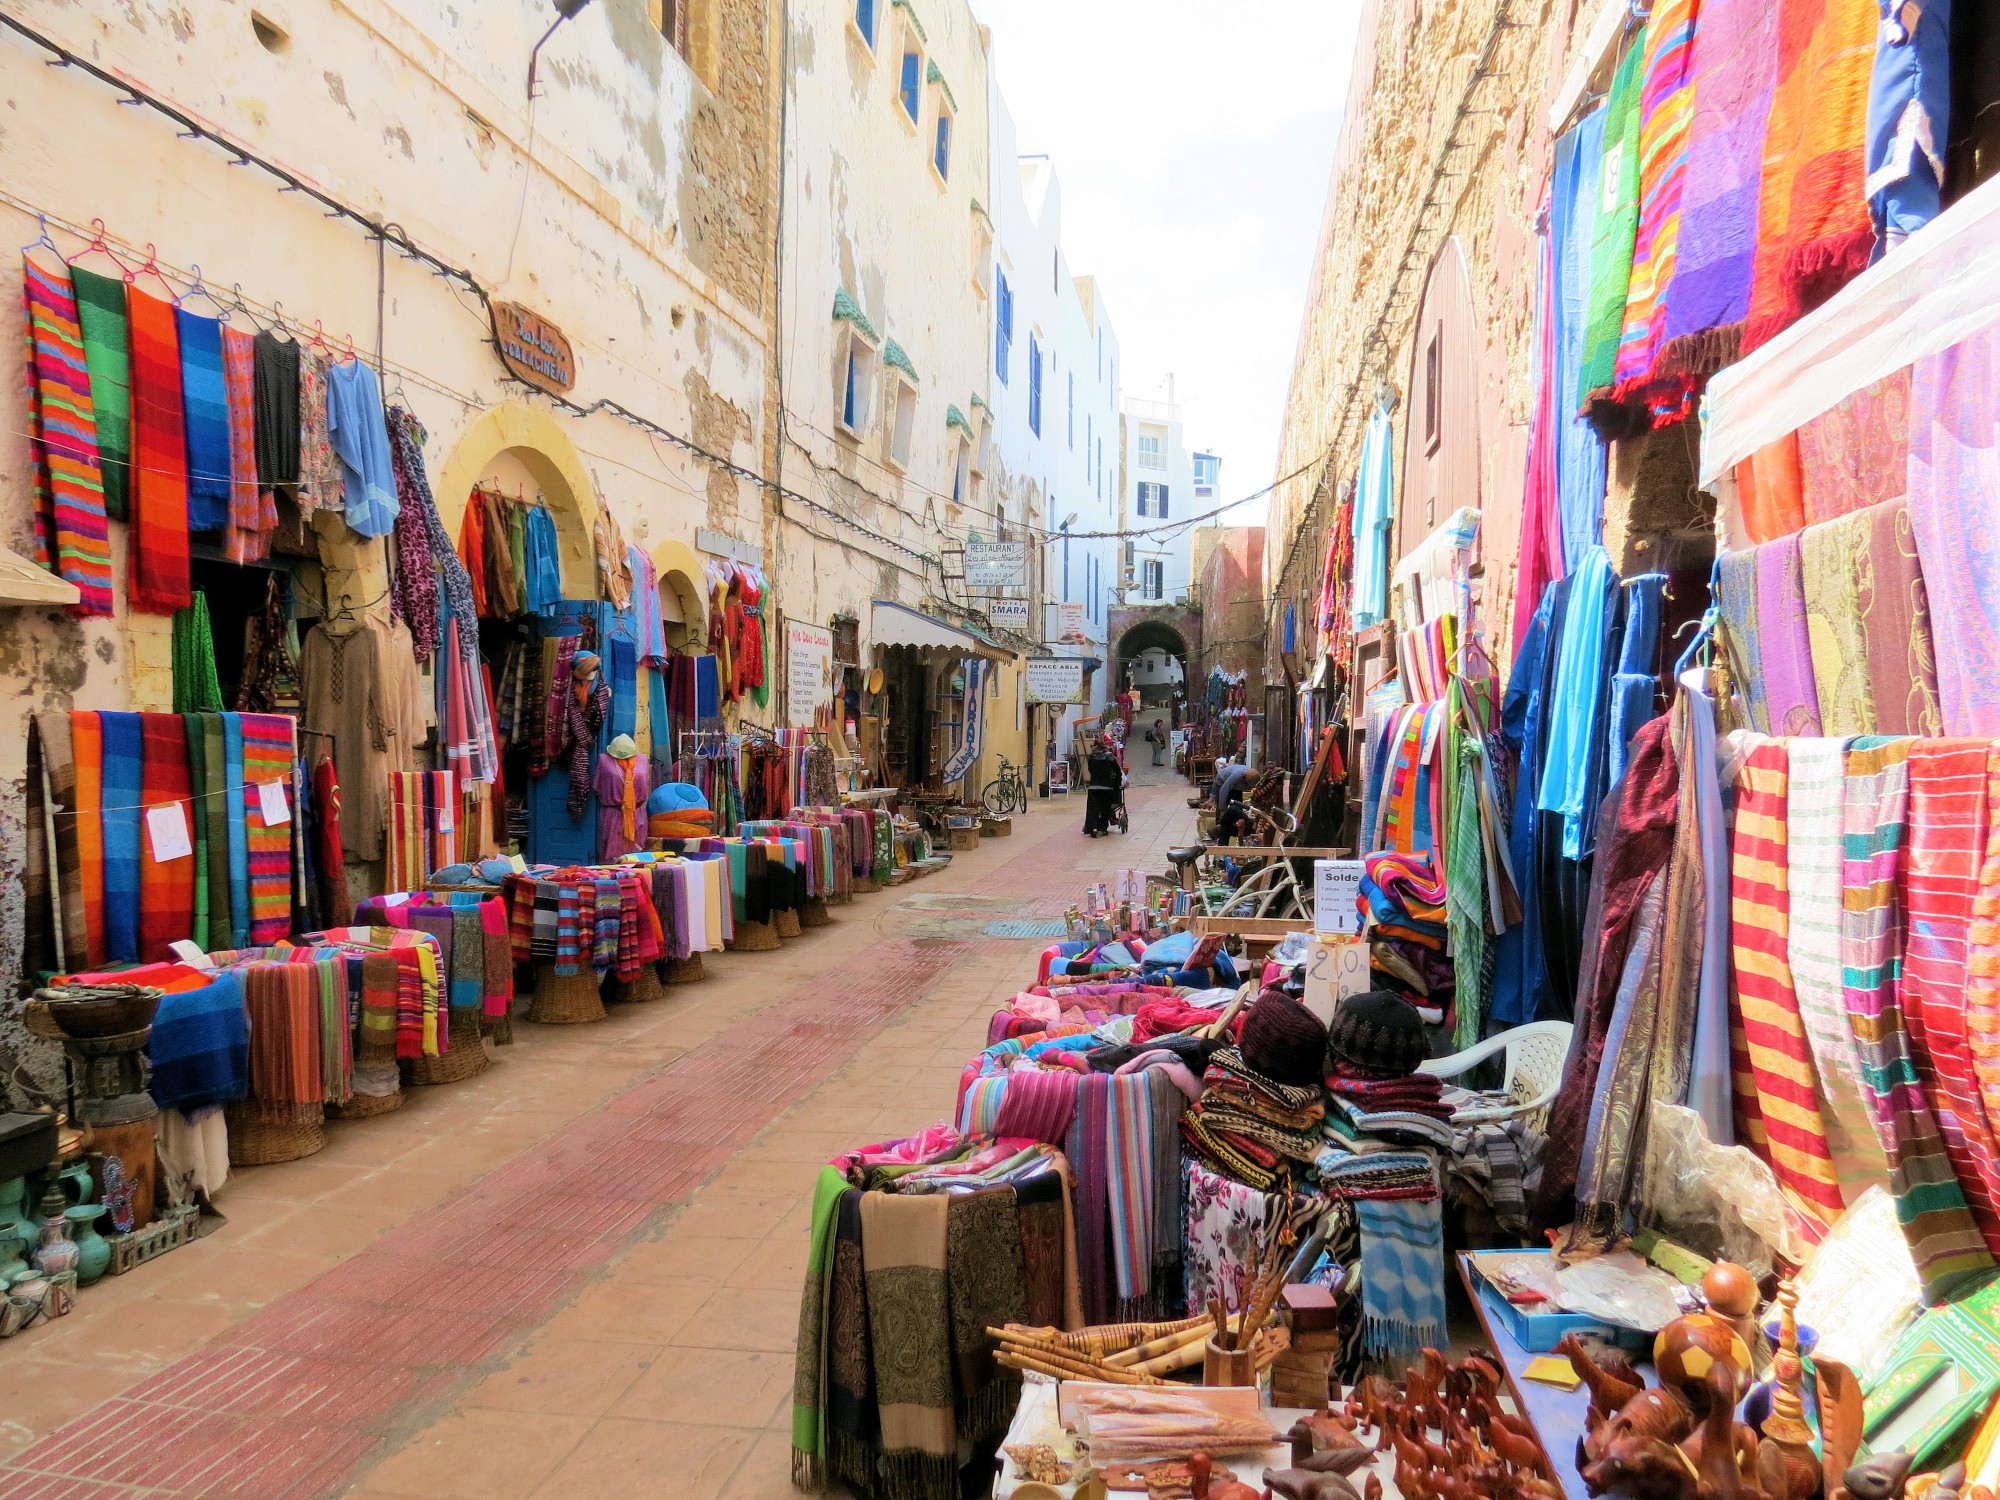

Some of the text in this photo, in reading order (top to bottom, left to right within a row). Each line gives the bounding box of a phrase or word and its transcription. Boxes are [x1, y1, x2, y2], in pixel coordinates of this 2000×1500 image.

[970, 544, 1015, 553] RESTAURANT
[991, 605, 1027, 615] SMARA
[1325, 873, 1359, 882] Solde
[1121, 880, 1138, 897] 10
